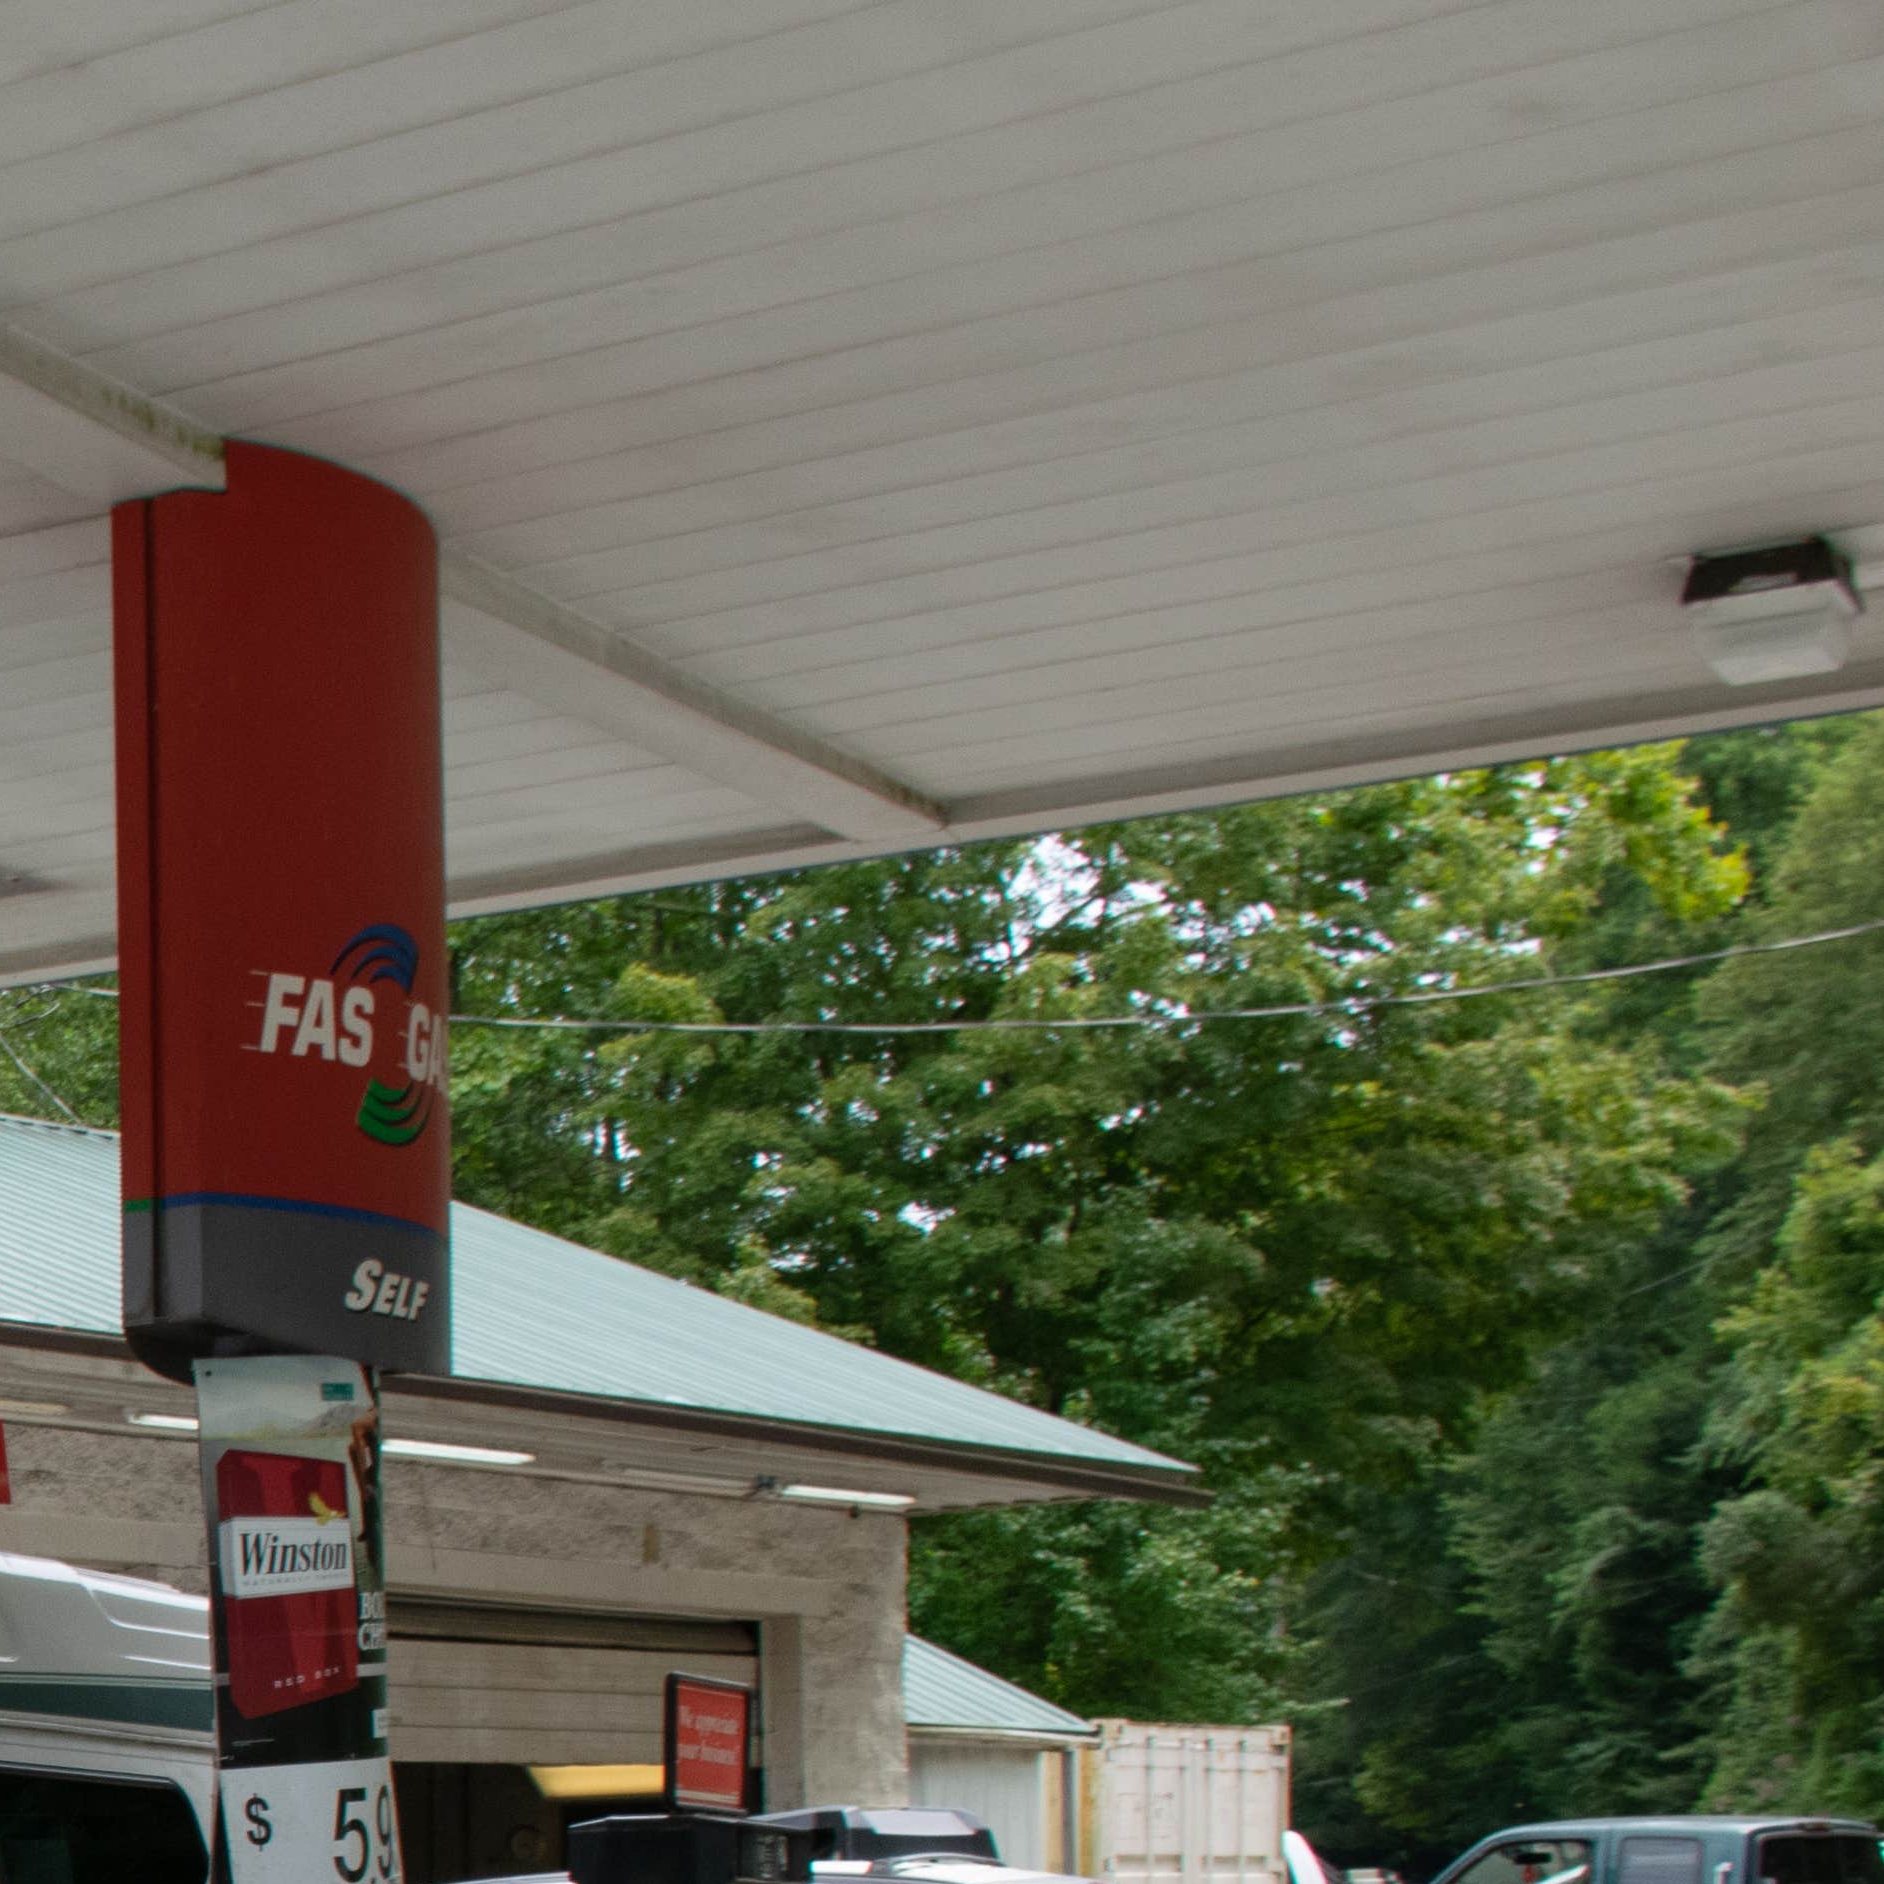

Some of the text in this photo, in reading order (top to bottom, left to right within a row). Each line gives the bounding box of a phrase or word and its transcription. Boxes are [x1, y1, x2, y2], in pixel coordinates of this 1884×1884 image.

[260, 973, 375, 1068] FAS
[344, 1259, 430, 1321] SELF
[239, 1531, 349, 1576] Winston
[273, 1665, 340, 1689] RED BOX
[245, 1792, 272, 1852] $
